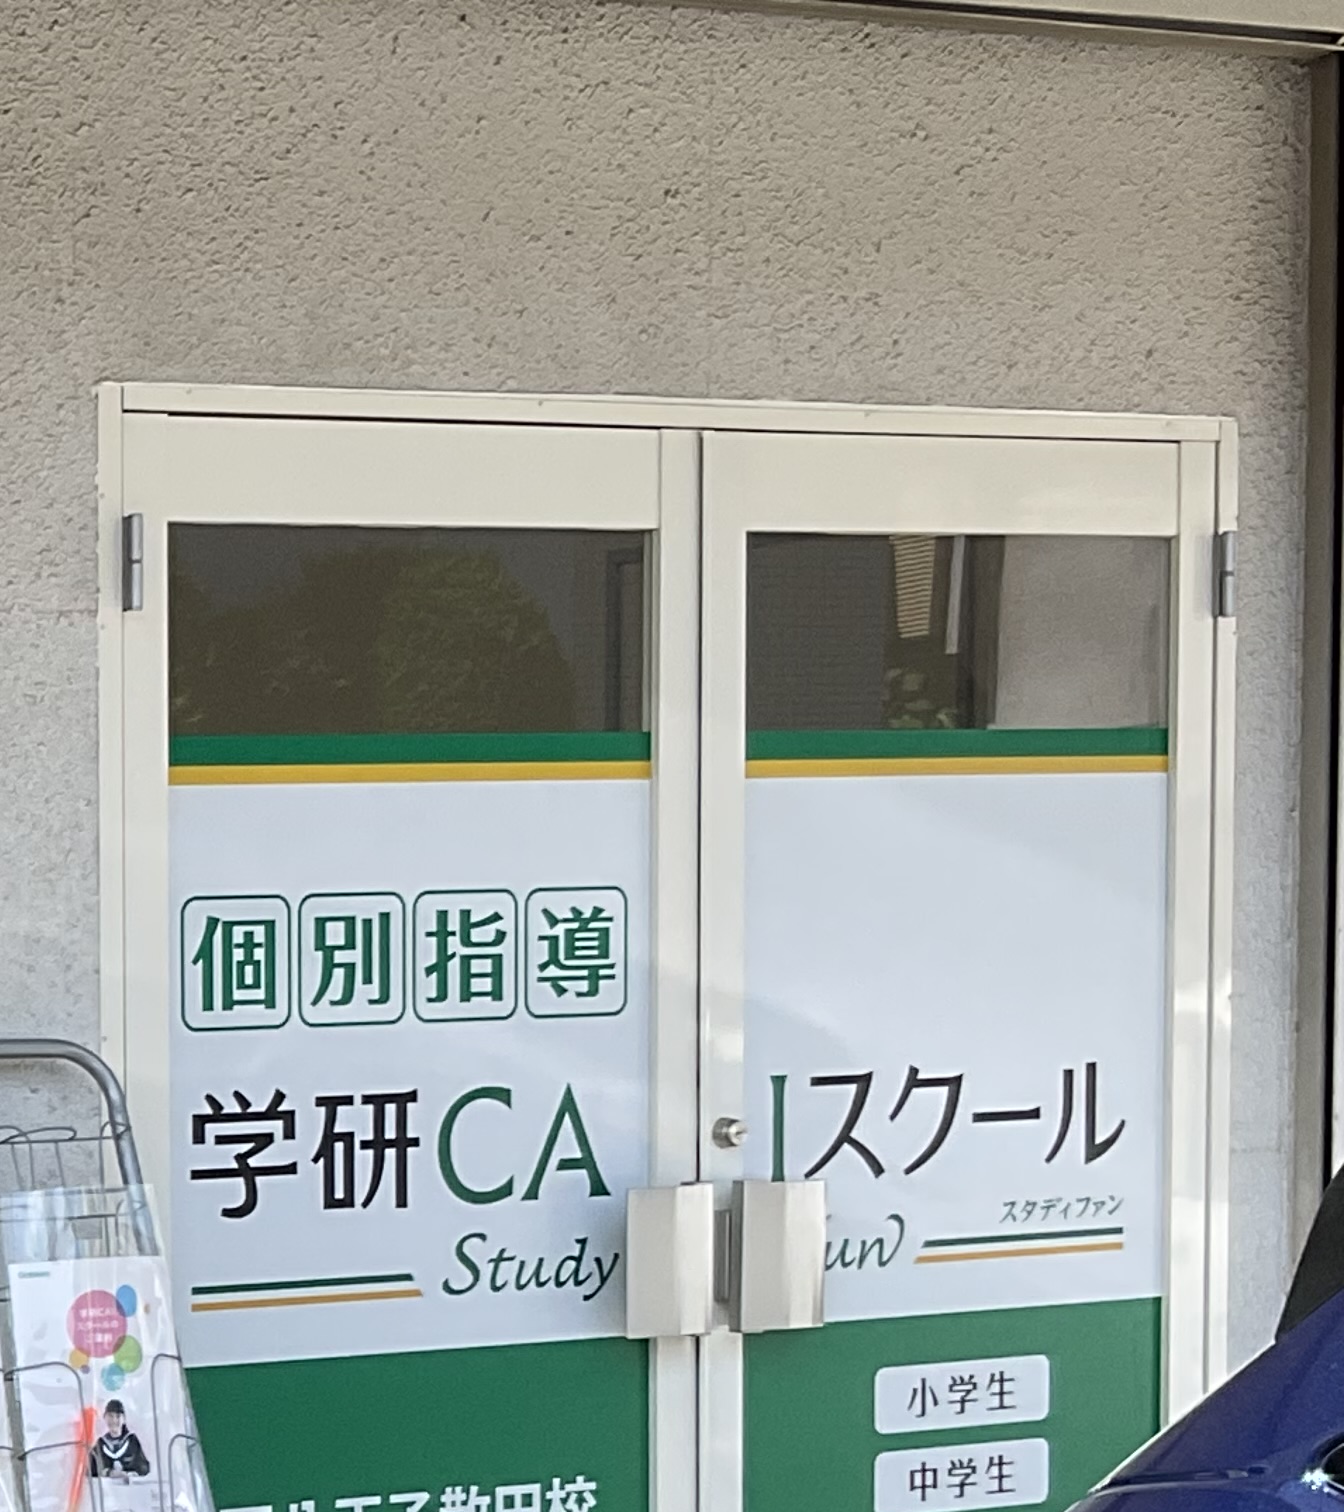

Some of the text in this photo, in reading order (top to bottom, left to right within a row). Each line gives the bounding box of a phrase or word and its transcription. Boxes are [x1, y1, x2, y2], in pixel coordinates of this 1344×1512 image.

[192, 906, 616, 1012] 個別指導
[999, 1195, 1124, 1225] スタディファン
[442, 1213, 905, 1301] Study un
[906, 1370, 1018, 1419] 小学生
[909, 1454, 1018, 1502] 中学生
